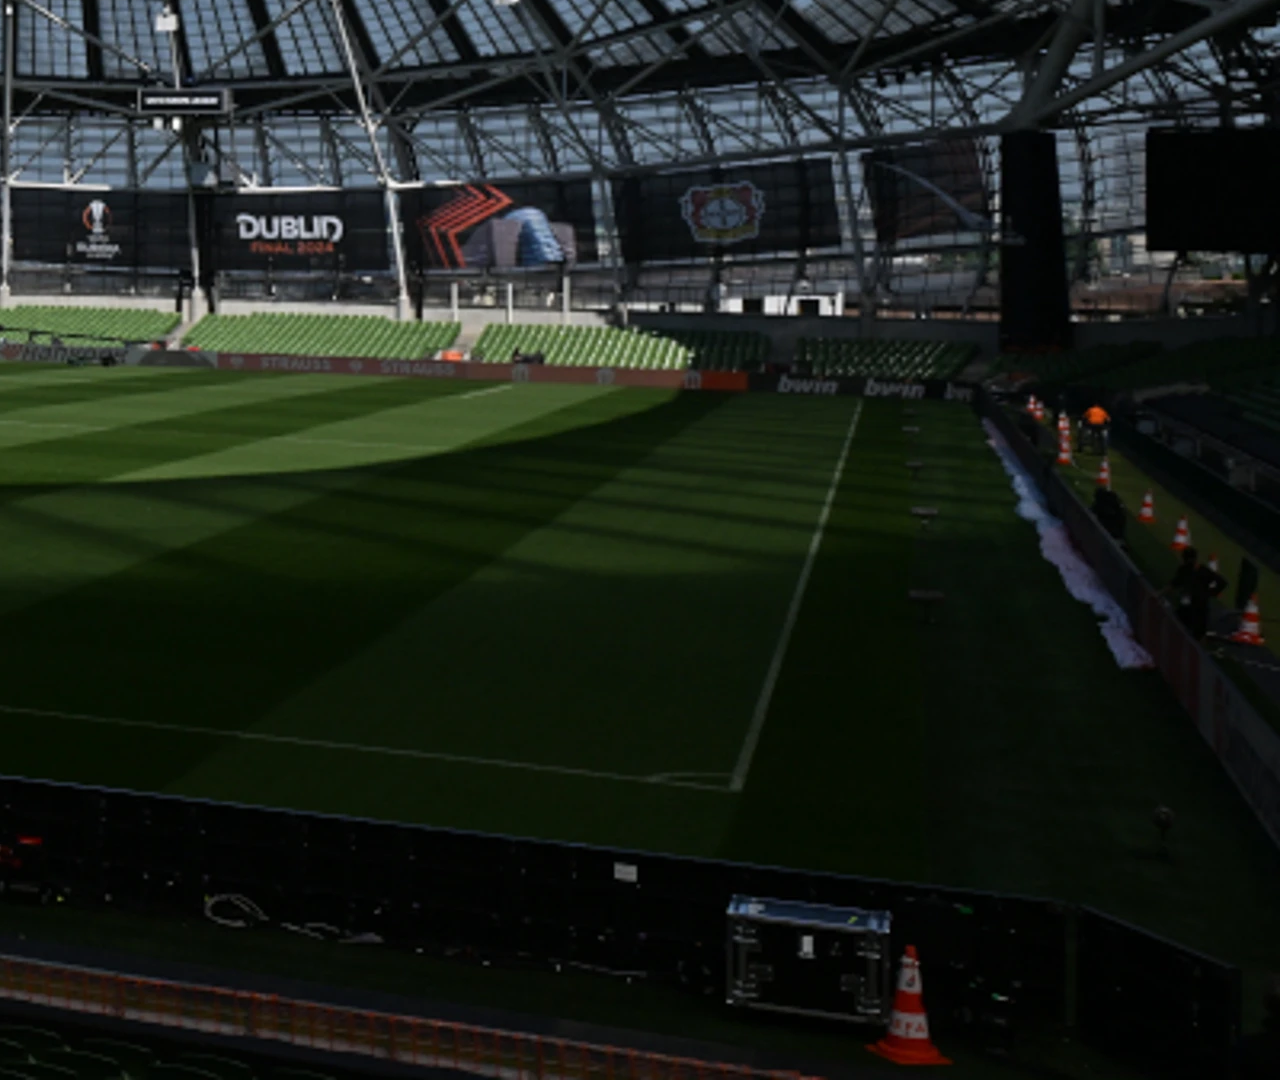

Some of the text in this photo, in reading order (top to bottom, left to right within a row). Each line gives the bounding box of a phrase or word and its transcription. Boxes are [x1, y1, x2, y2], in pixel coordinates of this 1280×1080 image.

[236, 212, 344, 242] DUBLIN
[249, 241, 334, 255] FINAL 2024
[777, 373, 839, 395] bwin
[864, 377, 926, 400] bwin
